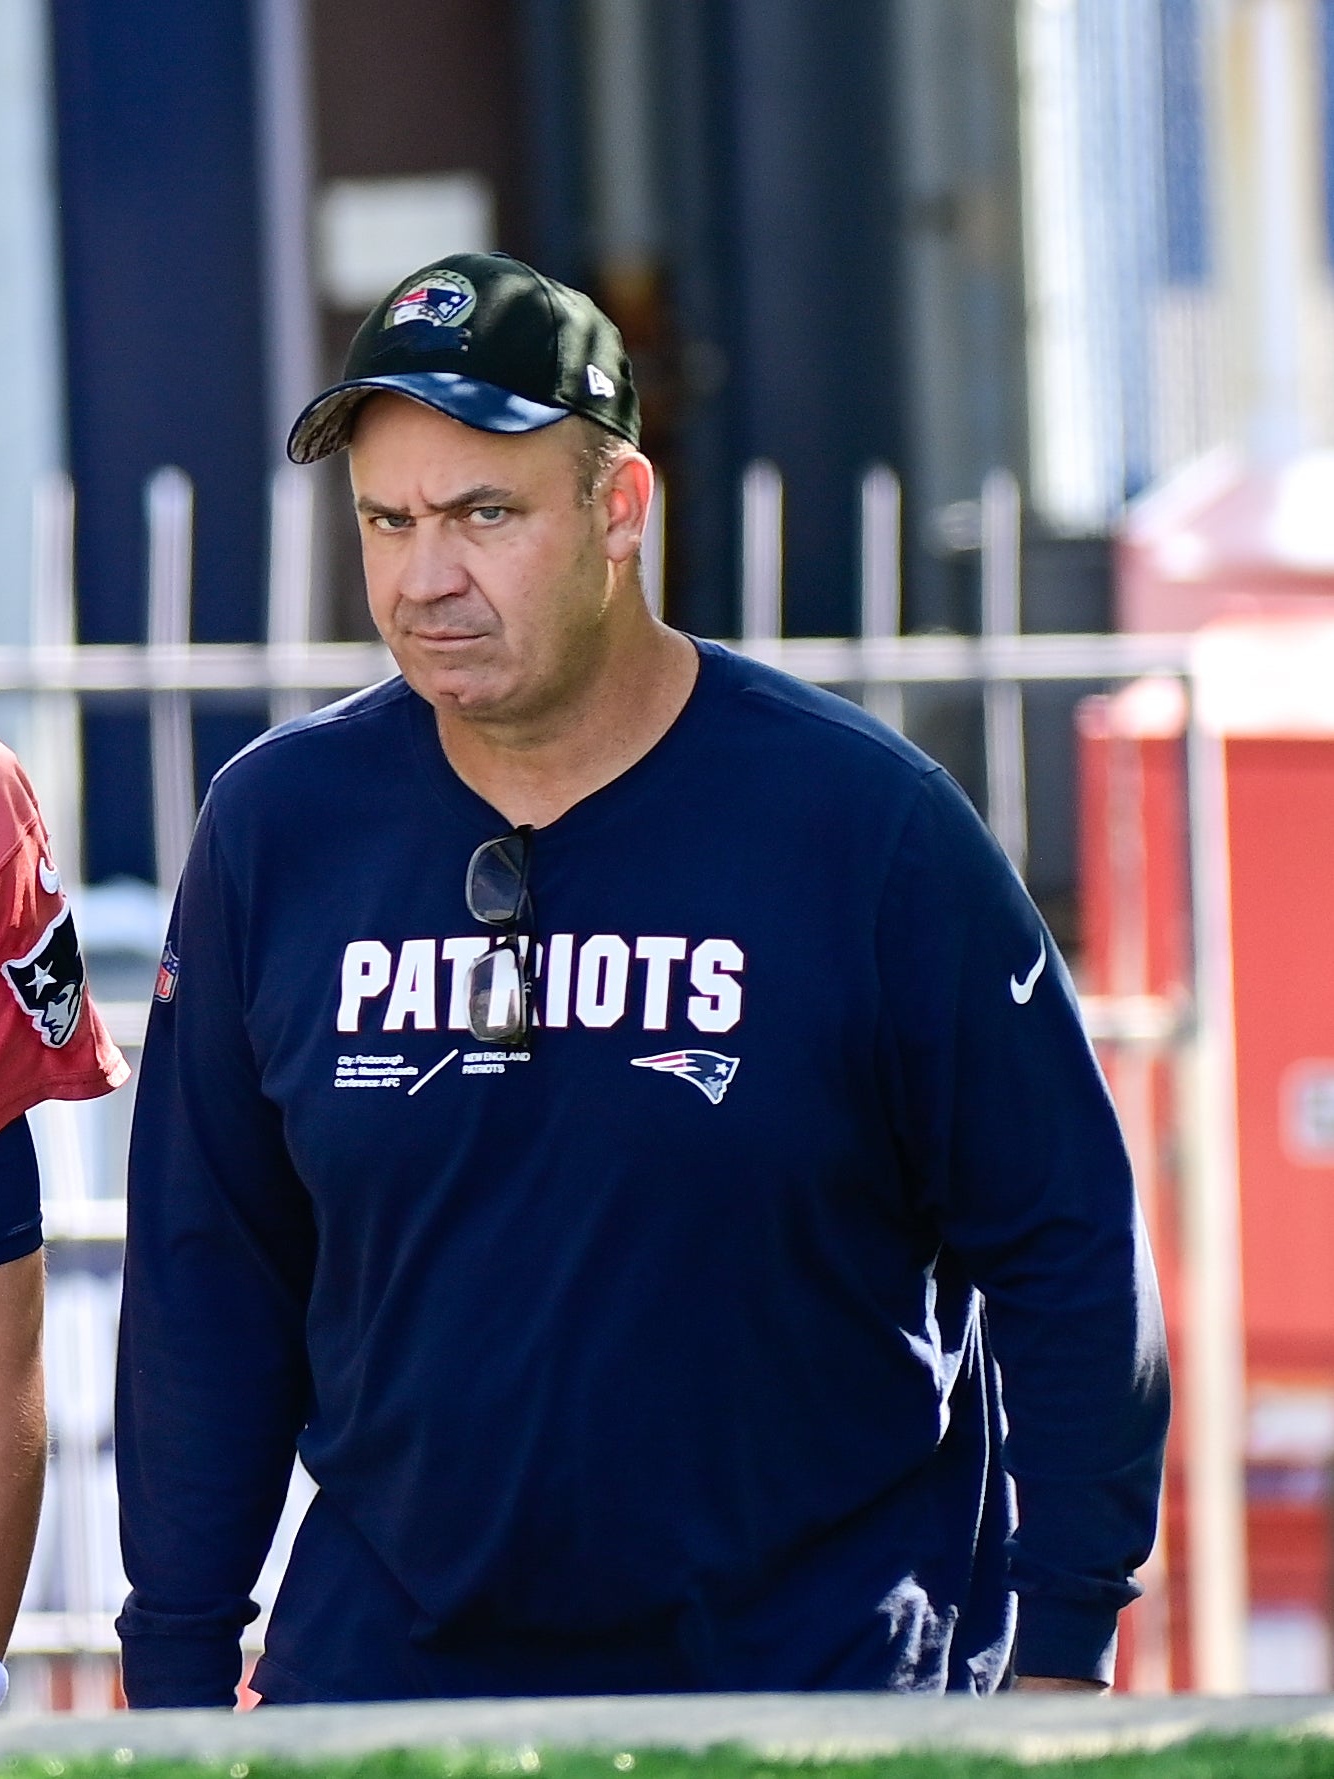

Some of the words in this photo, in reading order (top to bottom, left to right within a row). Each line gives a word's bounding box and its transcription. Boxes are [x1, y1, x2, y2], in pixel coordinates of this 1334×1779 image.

[484, 1052, 531, 1062] ENGLAND
[462, 1064, 505, 1075] PATRIOTS
[381, 1078, 401, 1088] AFC
